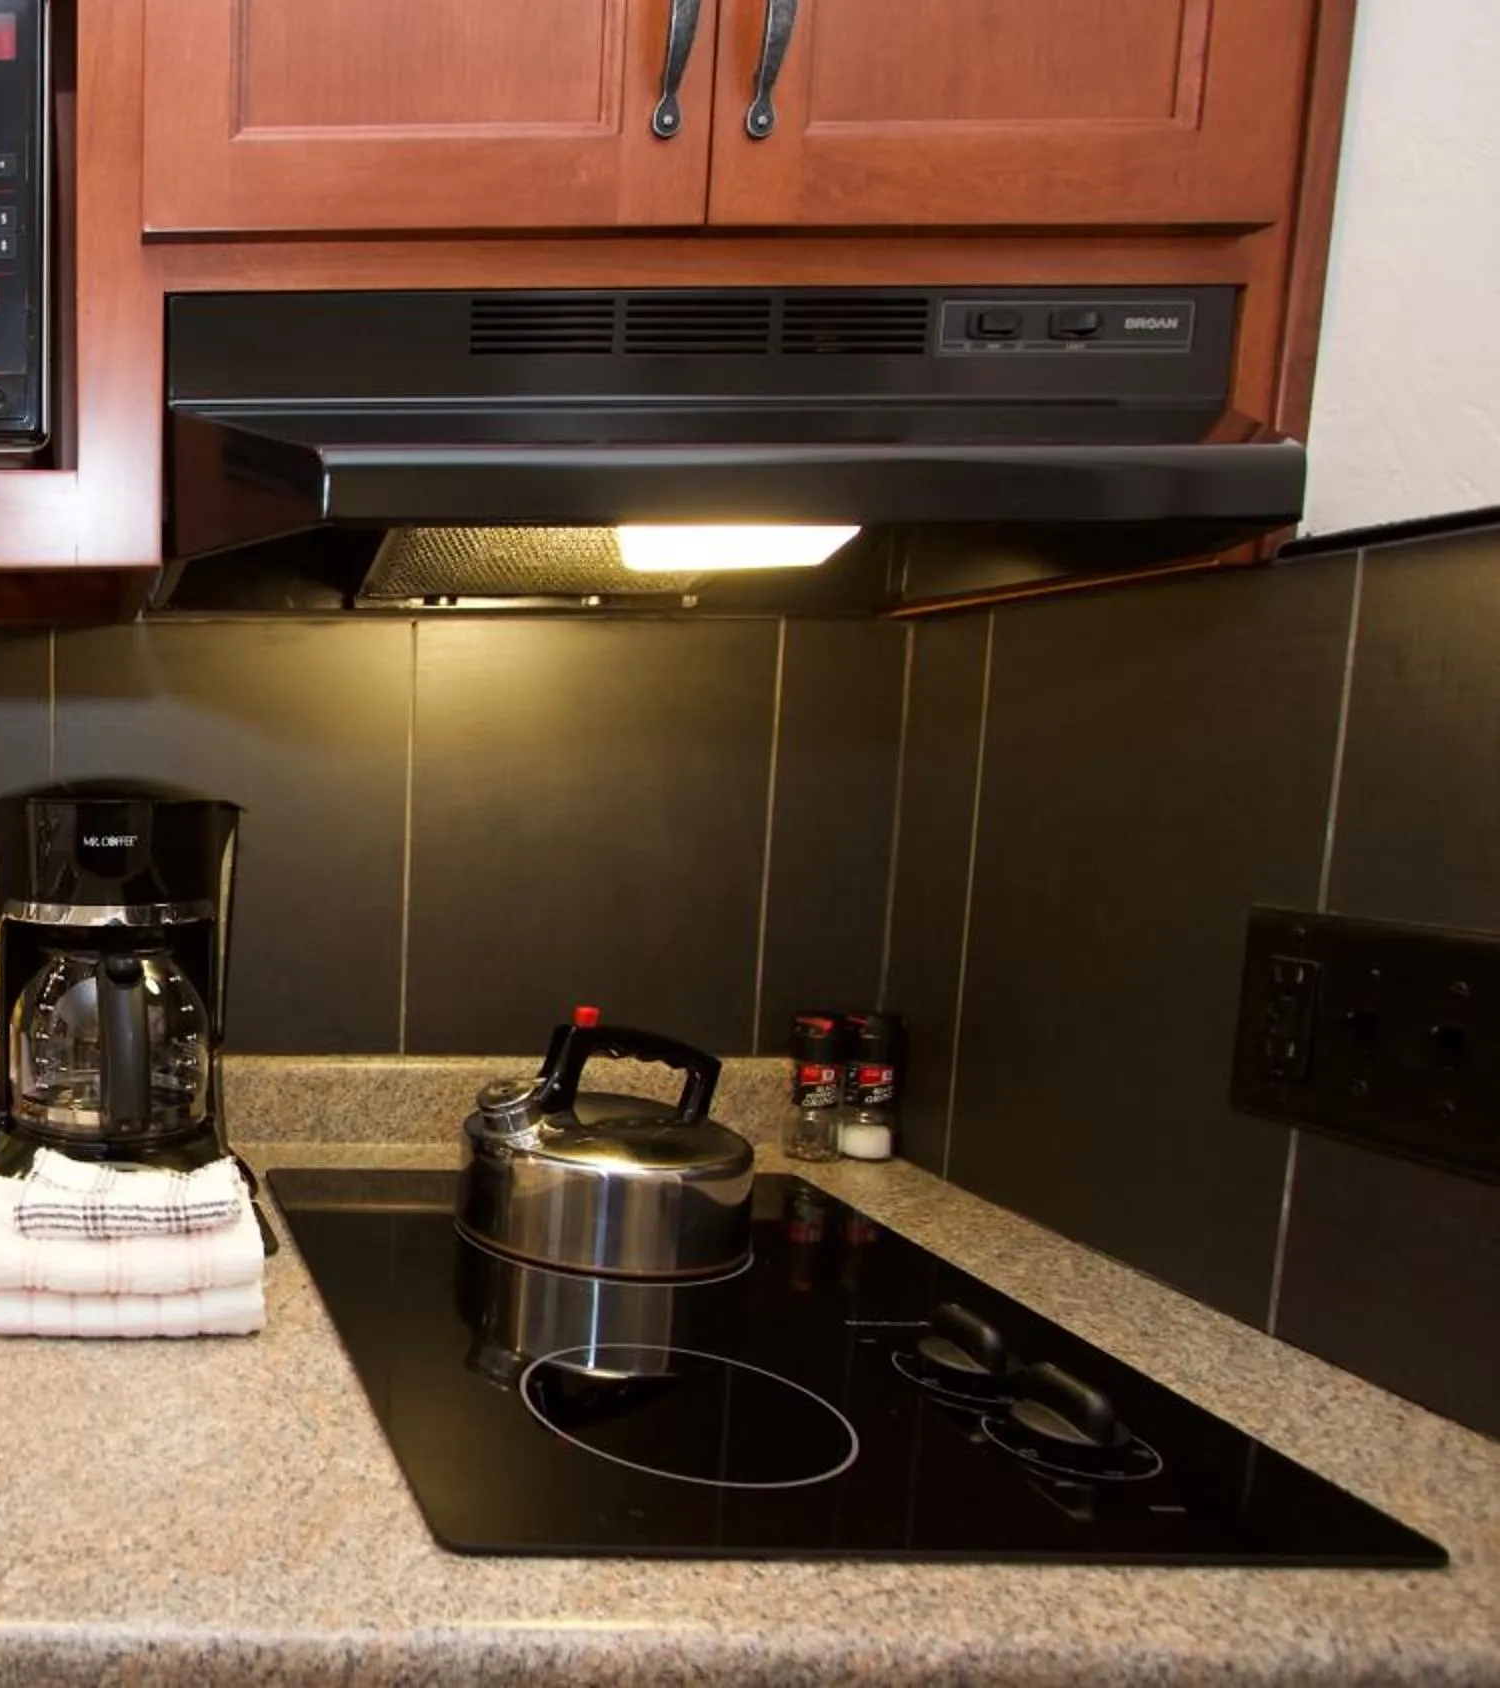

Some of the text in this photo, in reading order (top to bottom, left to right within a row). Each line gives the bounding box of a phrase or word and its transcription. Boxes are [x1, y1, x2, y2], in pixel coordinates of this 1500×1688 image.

[0, 212, 8, 225] 5
[1124, 317, 1179, 330] BROAN
[83, 834, 100, 847] MR.
